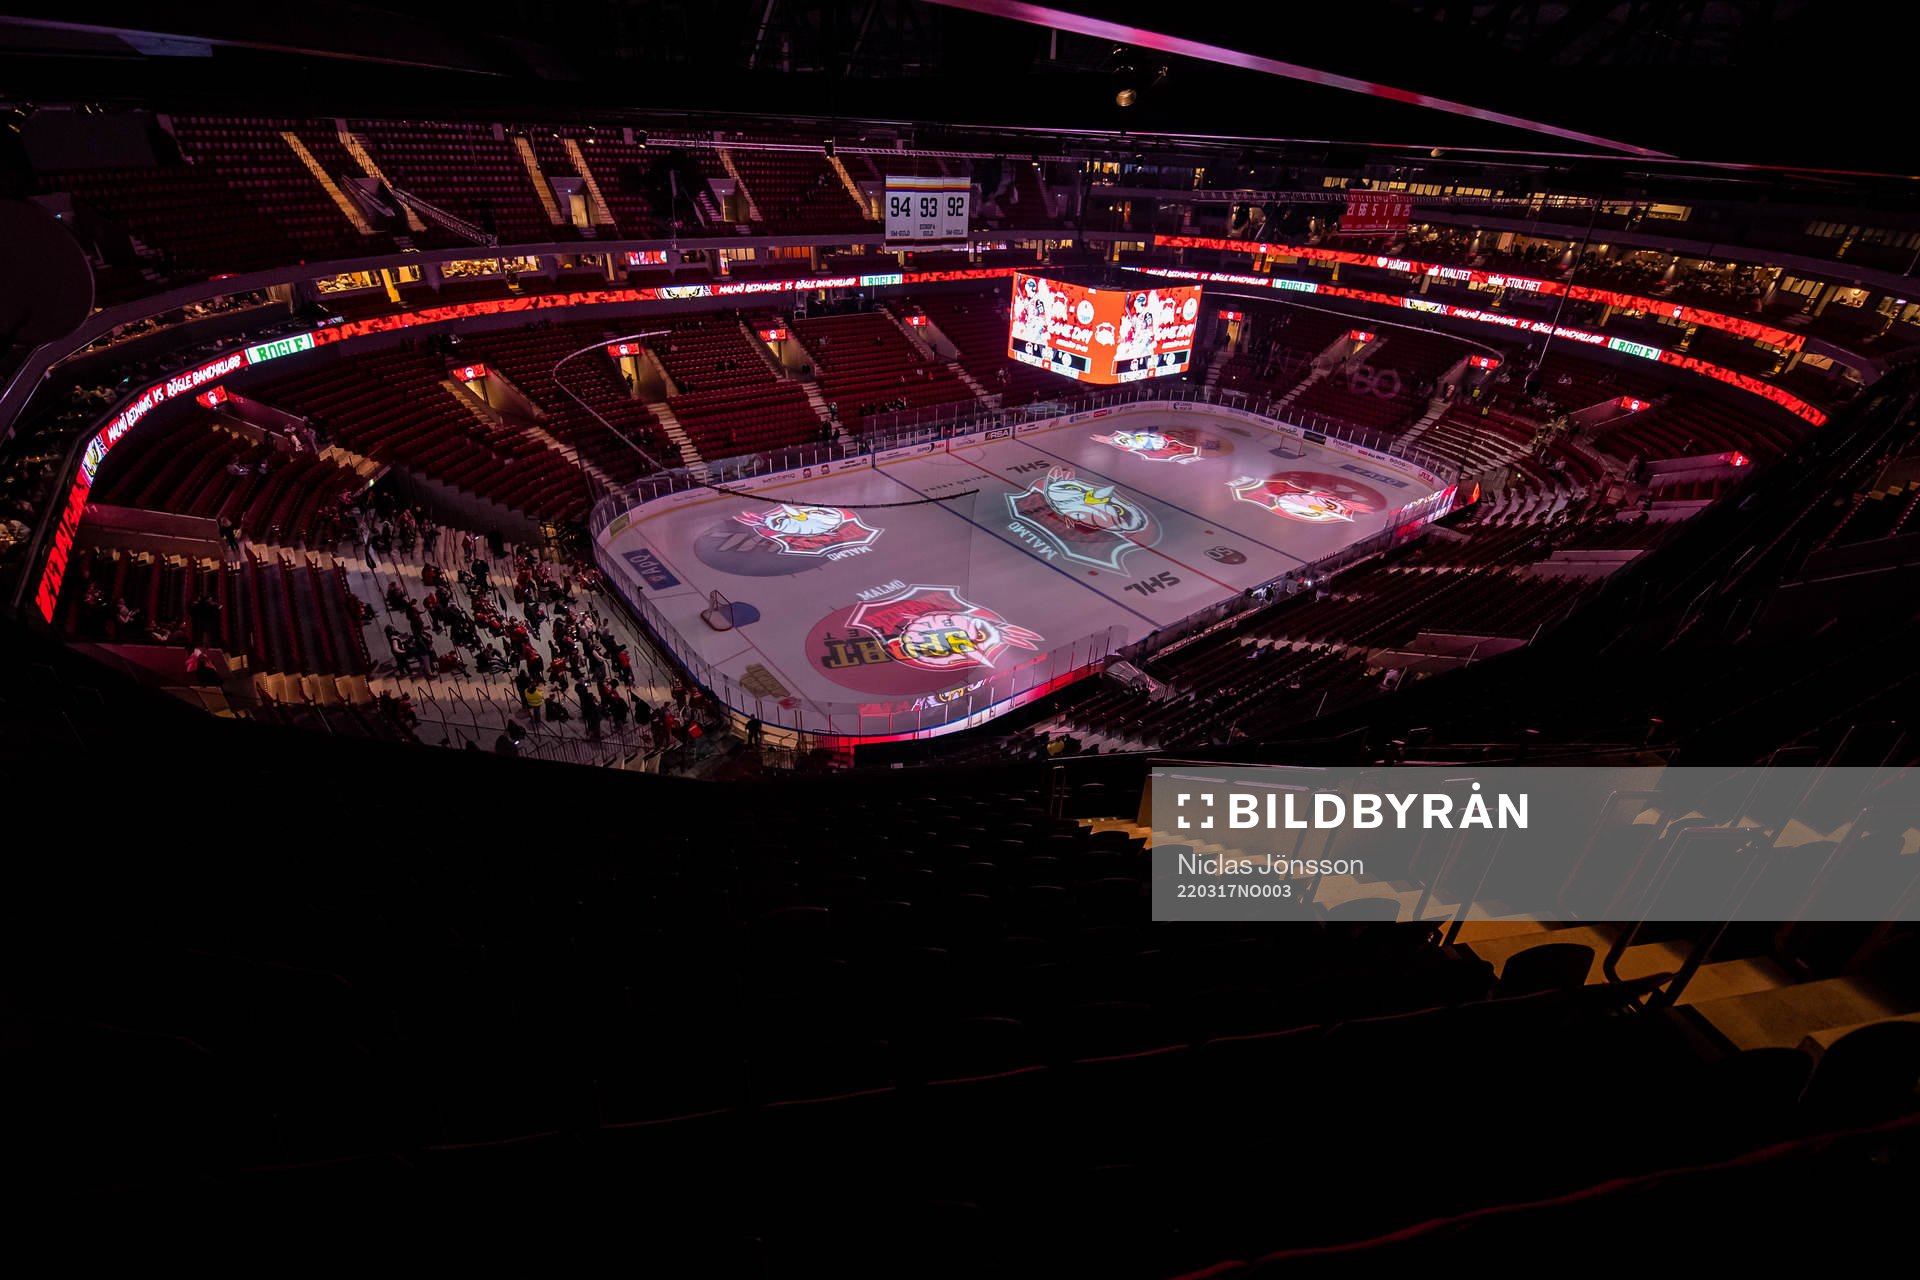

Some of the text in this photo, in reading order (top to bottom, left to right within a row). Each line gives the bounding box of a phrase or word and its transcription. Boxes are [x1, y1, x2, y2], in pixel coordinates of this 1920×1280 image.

[890, 196, 964, 218] 94 93 92
[1371, 203, 1379, 217] 5
[1439, 266, 1473, 281] KVALITET
[784, 281, 793, 290] VS
[1505, 277, 1543, 292] STOLTHET
[1519, 320, 1530, 329] VS
[126, 393, 153, 428] REDHAWKS
[152, 387, 165, 403] VS
[166, 377, 193, 397] RÖGLE
[192, 354, 241, 385] BANDYKLUBB
[990, 428, 1010, 440] RSA
[1005, 460, 1051, 475] SHL
[1123, 571, 1181, 597] SHL
